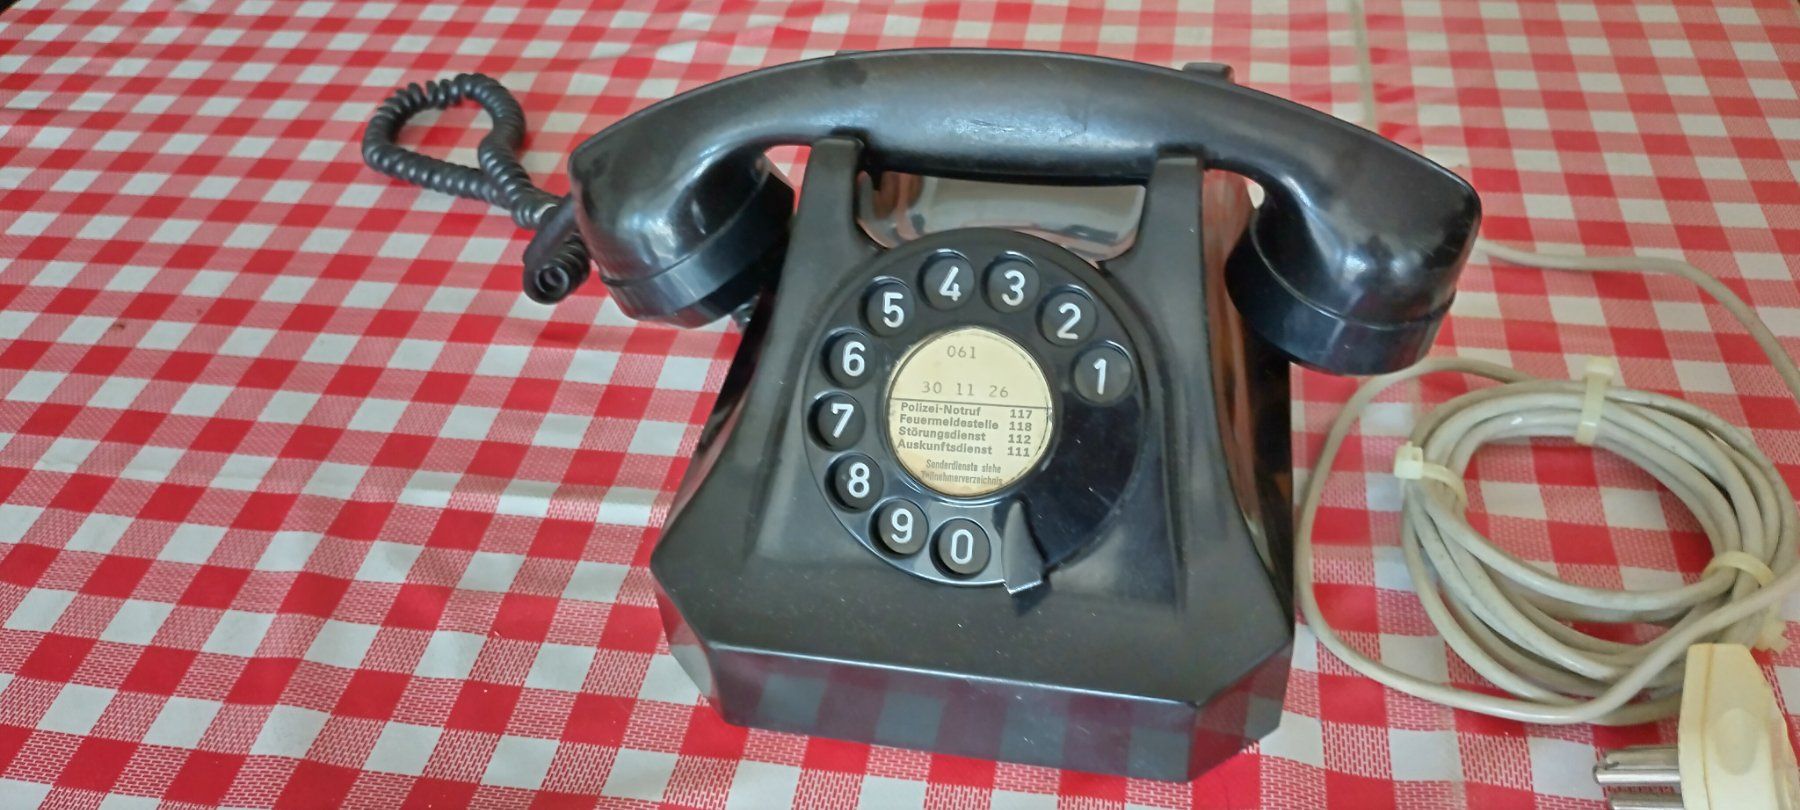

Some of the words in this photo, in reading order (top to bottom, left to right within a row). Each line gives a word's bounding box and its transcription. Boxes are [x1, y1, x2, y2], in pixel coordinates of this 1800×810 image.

[939, 266, 962, 301] 4
[1002, 270, 1026, 306] 3
[882, 291, 905, 328] 5
[1056, 302, 1082, 340] 2
[842, 341, 866, 377] 6
[946, 345, 977, 359] 061
[921, 381, 943, 394] 30
[956, 383, 975, 397] 11
[988, 385, 1009, 398] 26
[1093, 358, 1107, 395] 1
[831, 403, 854, 438] 7
[899, 414, 999, 430] Feuermeldestelle
[1008, 421, 1032, 432] 118
[900, 402, 982, 417] Polizei-Notruf
[1009, 409, 1033, 420] 117
[897, 439, 993, 455] Auskunftsdienst
[1007, 446, 1031, 458] 111
[898, 426, 987, 442] Störungsdienst
[1007, 434, 1032, 445] 112
[848, 462, 871, 498] 8
[981, 464, 1002, 474] siehe
[890, 508, 914, 544] 9
[950, 529, 974, 565] 0
